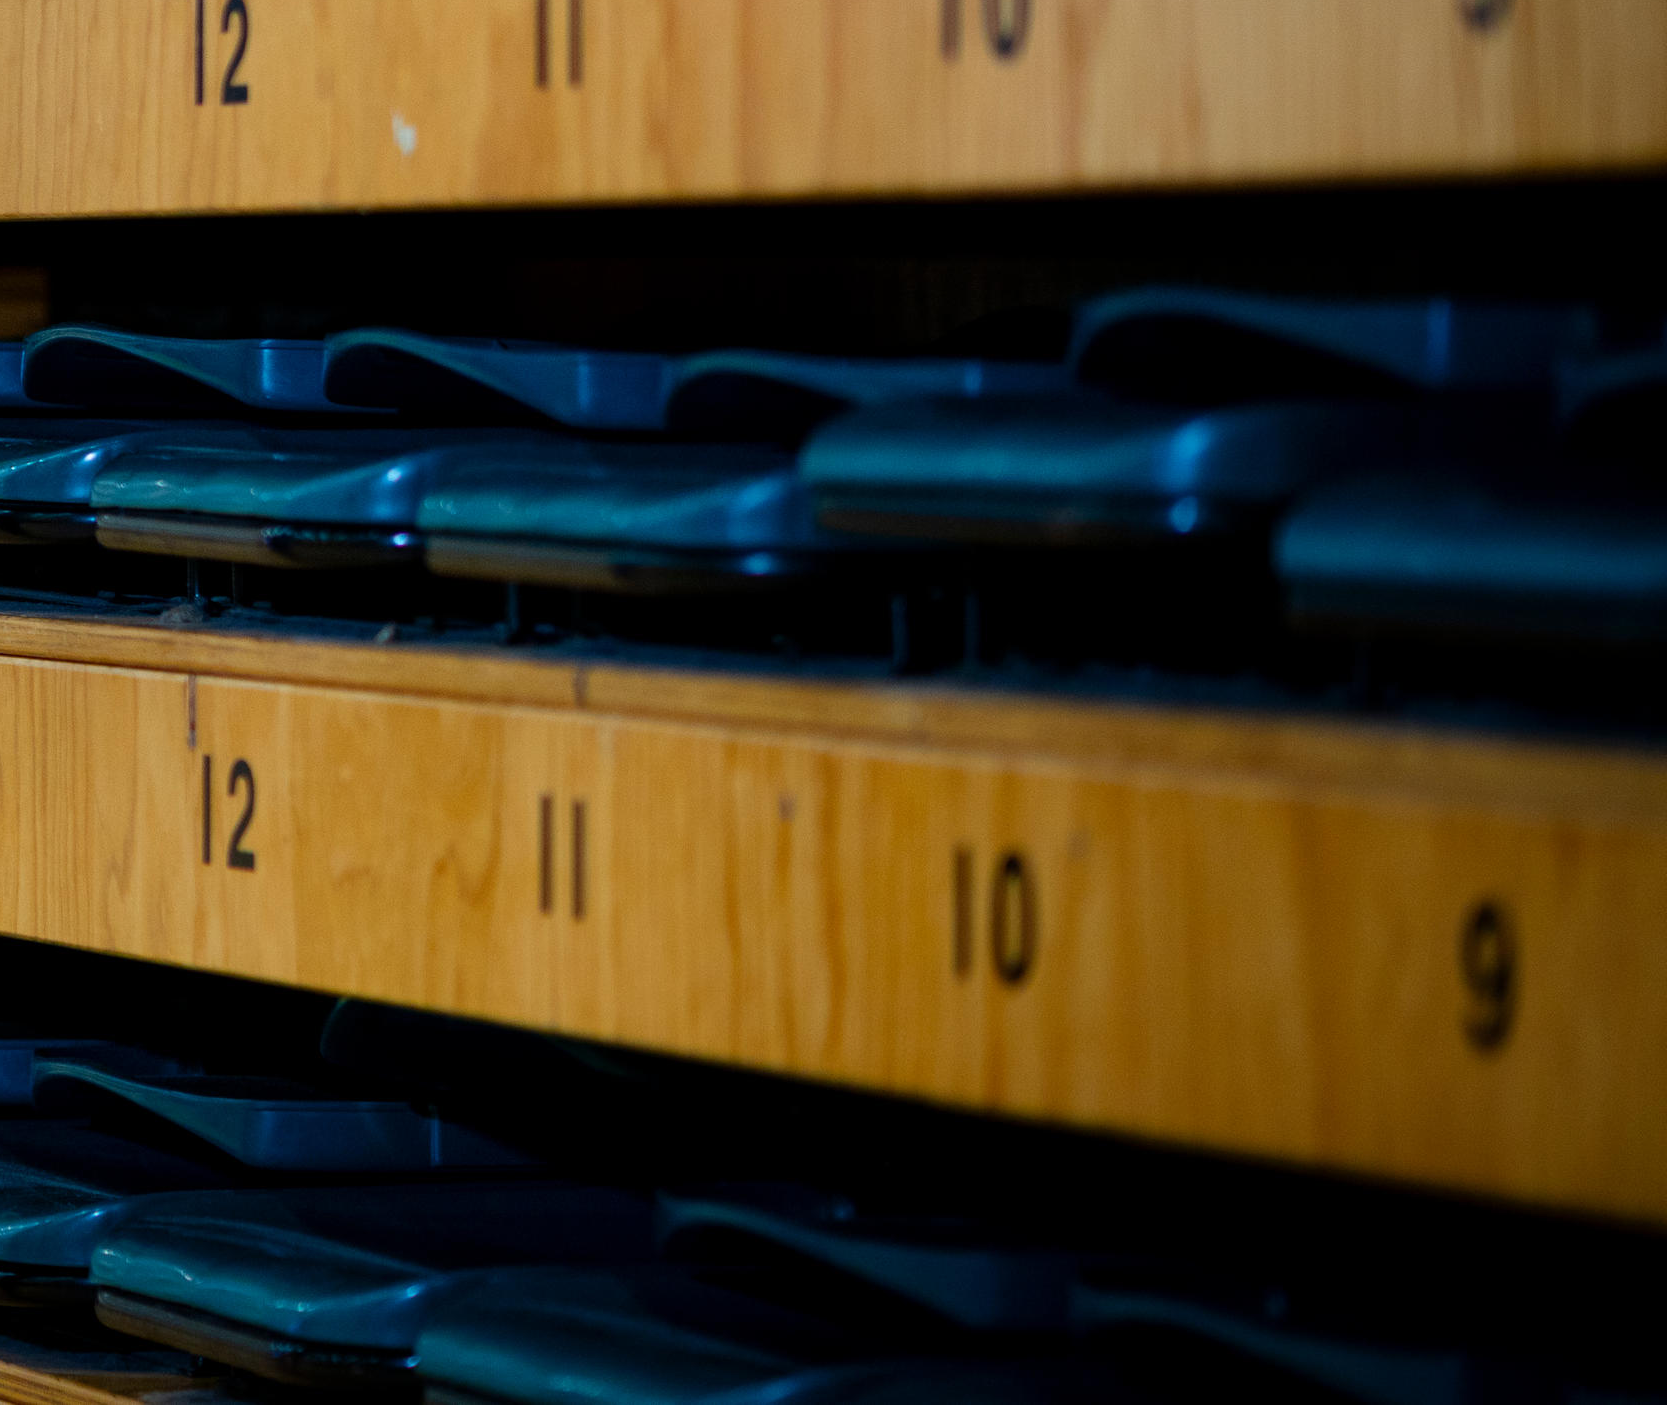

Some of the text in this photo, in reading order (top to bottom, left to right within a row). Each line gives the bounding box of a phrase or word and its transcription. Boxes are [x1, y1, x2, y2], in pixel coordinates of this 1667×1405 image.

[203, 755, 255, 870] 12
[539, 796, 586, 921] 11
[956, 851, 1035, 988] 10
[1464, 902, 1516, 1052] 9
